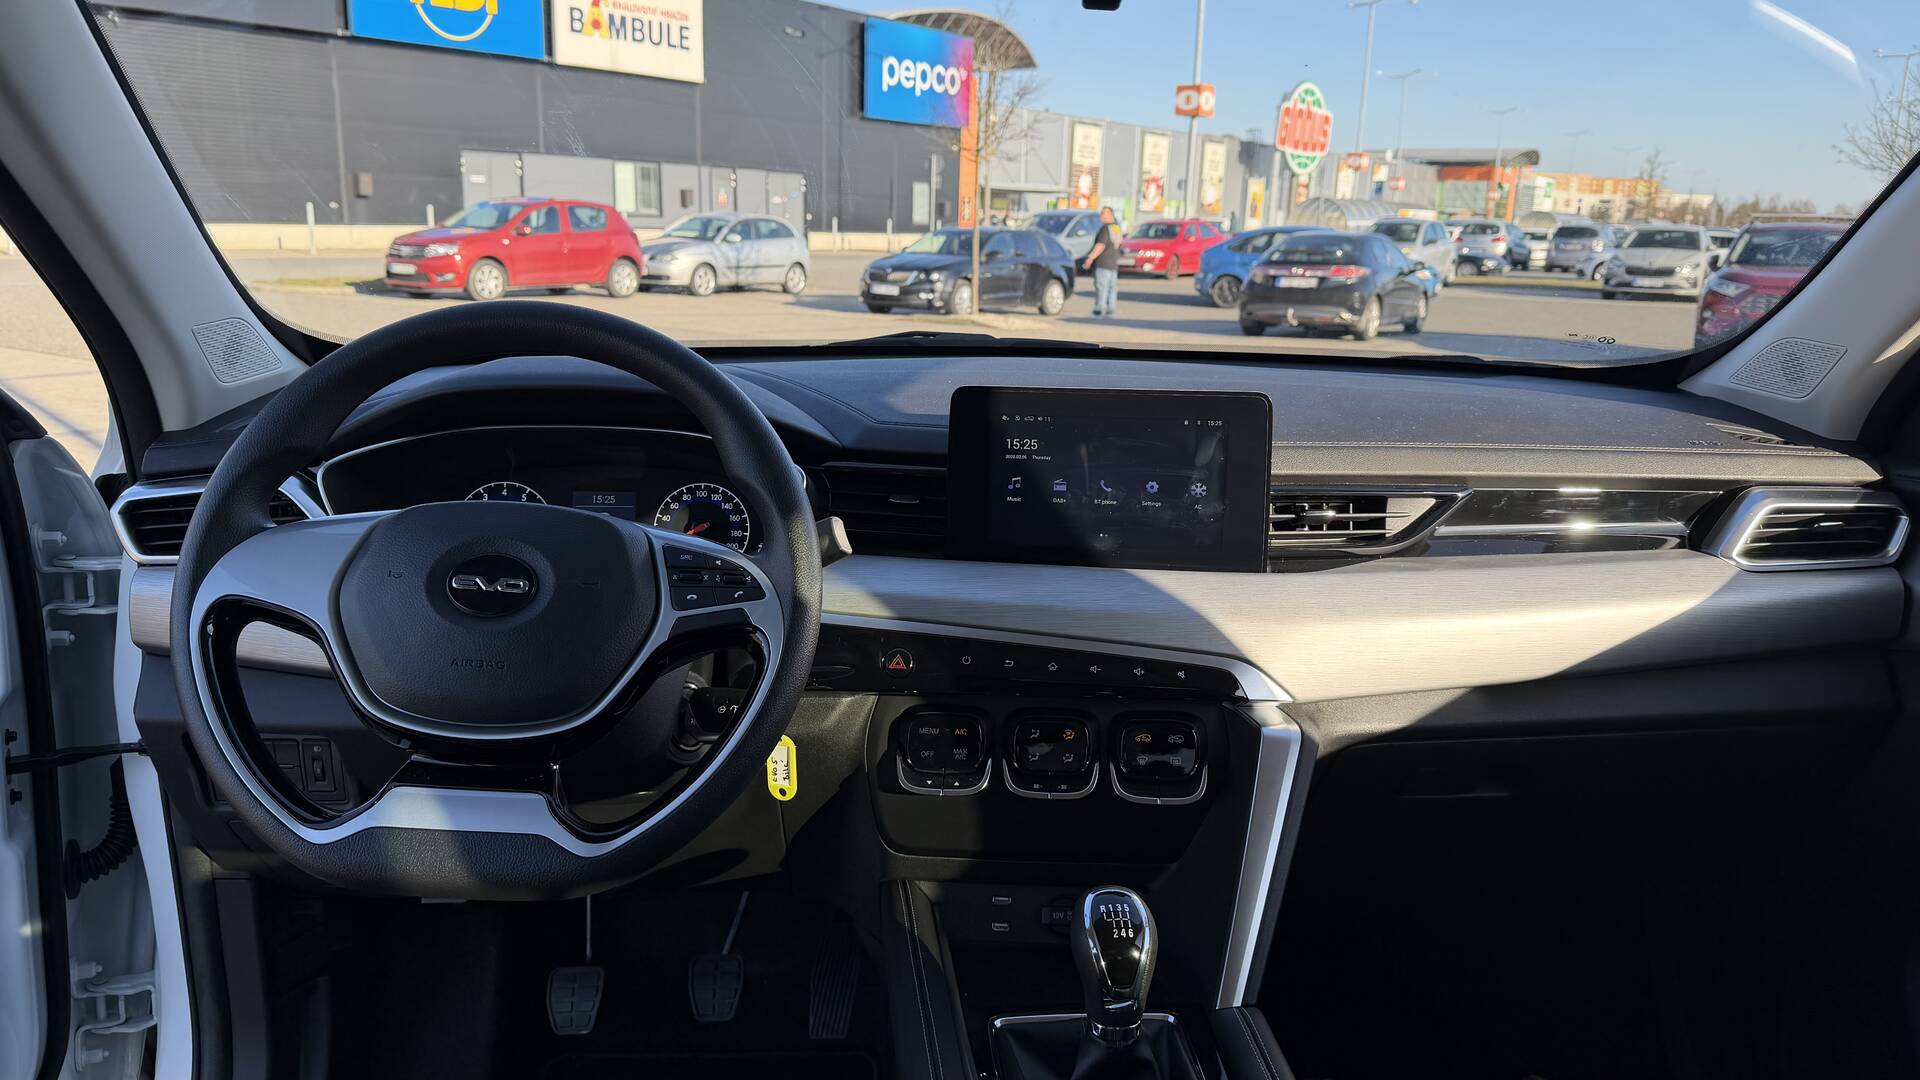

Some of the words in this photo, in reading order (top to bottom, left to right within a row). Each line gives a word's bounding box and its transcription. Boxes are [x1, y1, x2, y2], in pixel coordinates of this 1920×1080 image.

[569, 6, 690, 50] BAMBULE
[882, 56, 960, 97] pepco
[1006, 438, 1038, 450] 15:25
[482, 493, 488, 501] 3
[501, 488, 507, 496] 4
[592, 495, 616, 504] 15:25
[452, 575, 529, 593] EVO
[451, 658, 506, 669] AIRBAG
[918, 727, 940, 735] MENU
[1100, 904, 1106, 913] R
[1109, 904, 1113, 912] 1
[1117, 903, 1122, 911] 3
[1124, 903, 1130, 912] 5
[1113, 929, 1119, 938] 2
[1120, 929, 1126, 938] 4
[1128, 929, 1134, 938] 6
